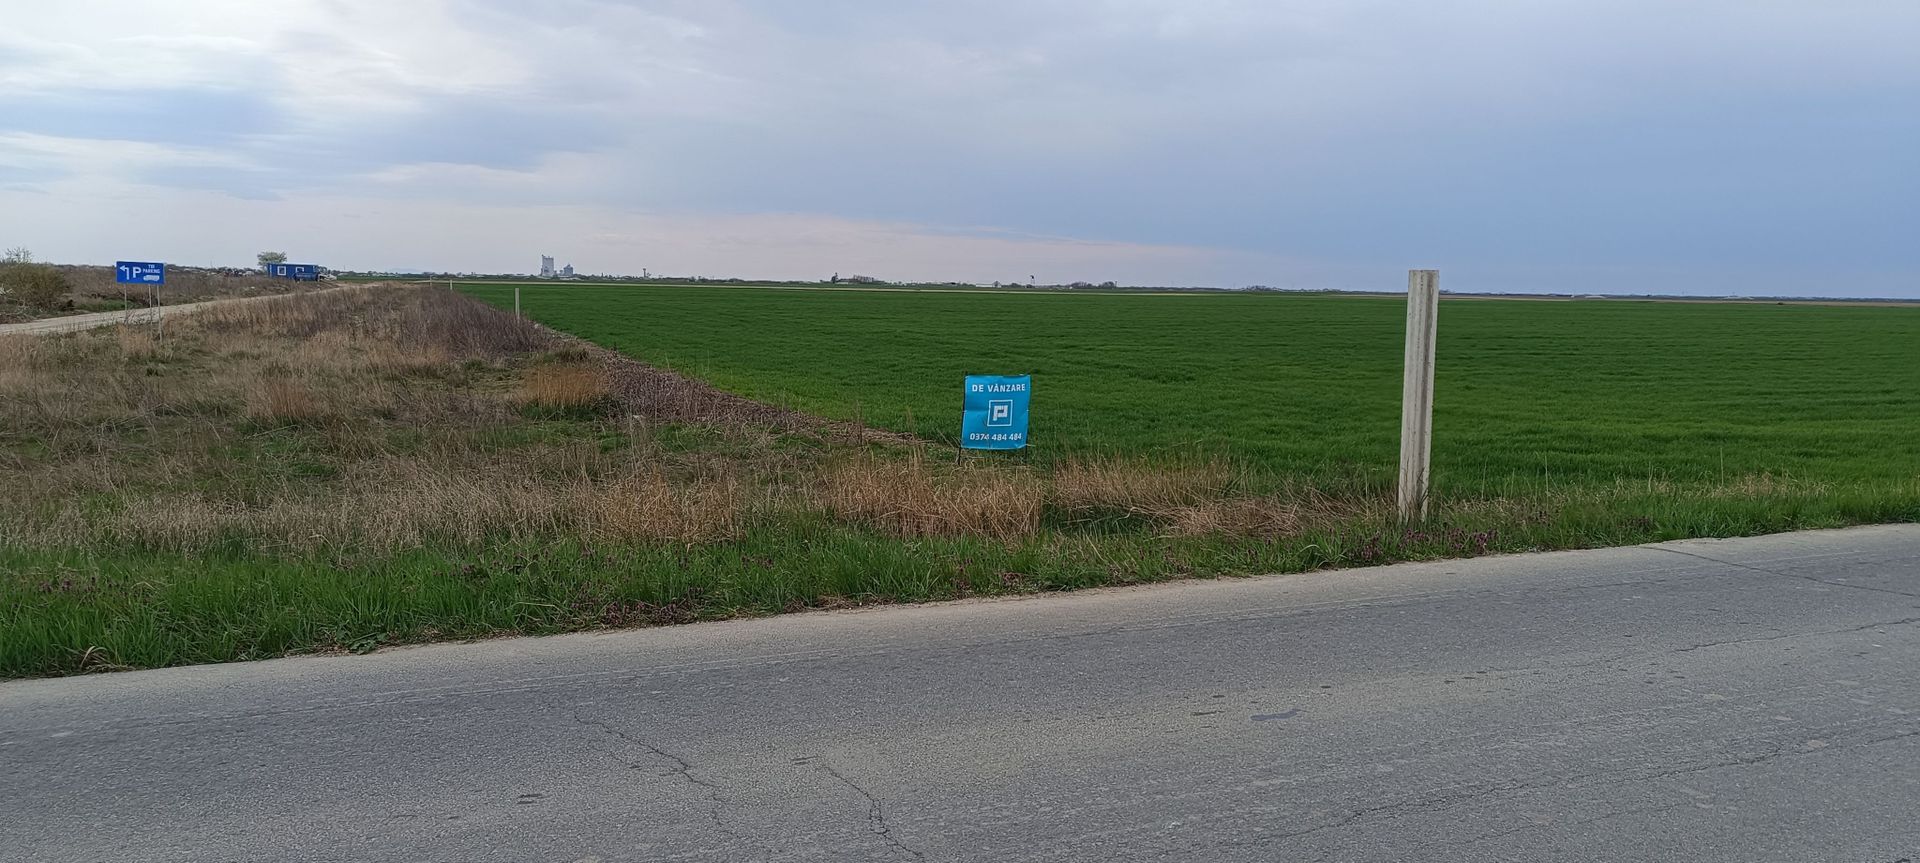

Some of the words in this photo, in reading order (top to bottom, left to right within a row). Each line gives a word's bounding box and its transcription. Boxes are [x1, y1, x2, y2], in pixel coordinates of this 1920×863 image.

[132, 266, 141, 278] P
[972, 384, 984, 392] DE
[987, 384, 1026, 392] VÂNZARE
[991, 433, 1007, 441] 484
